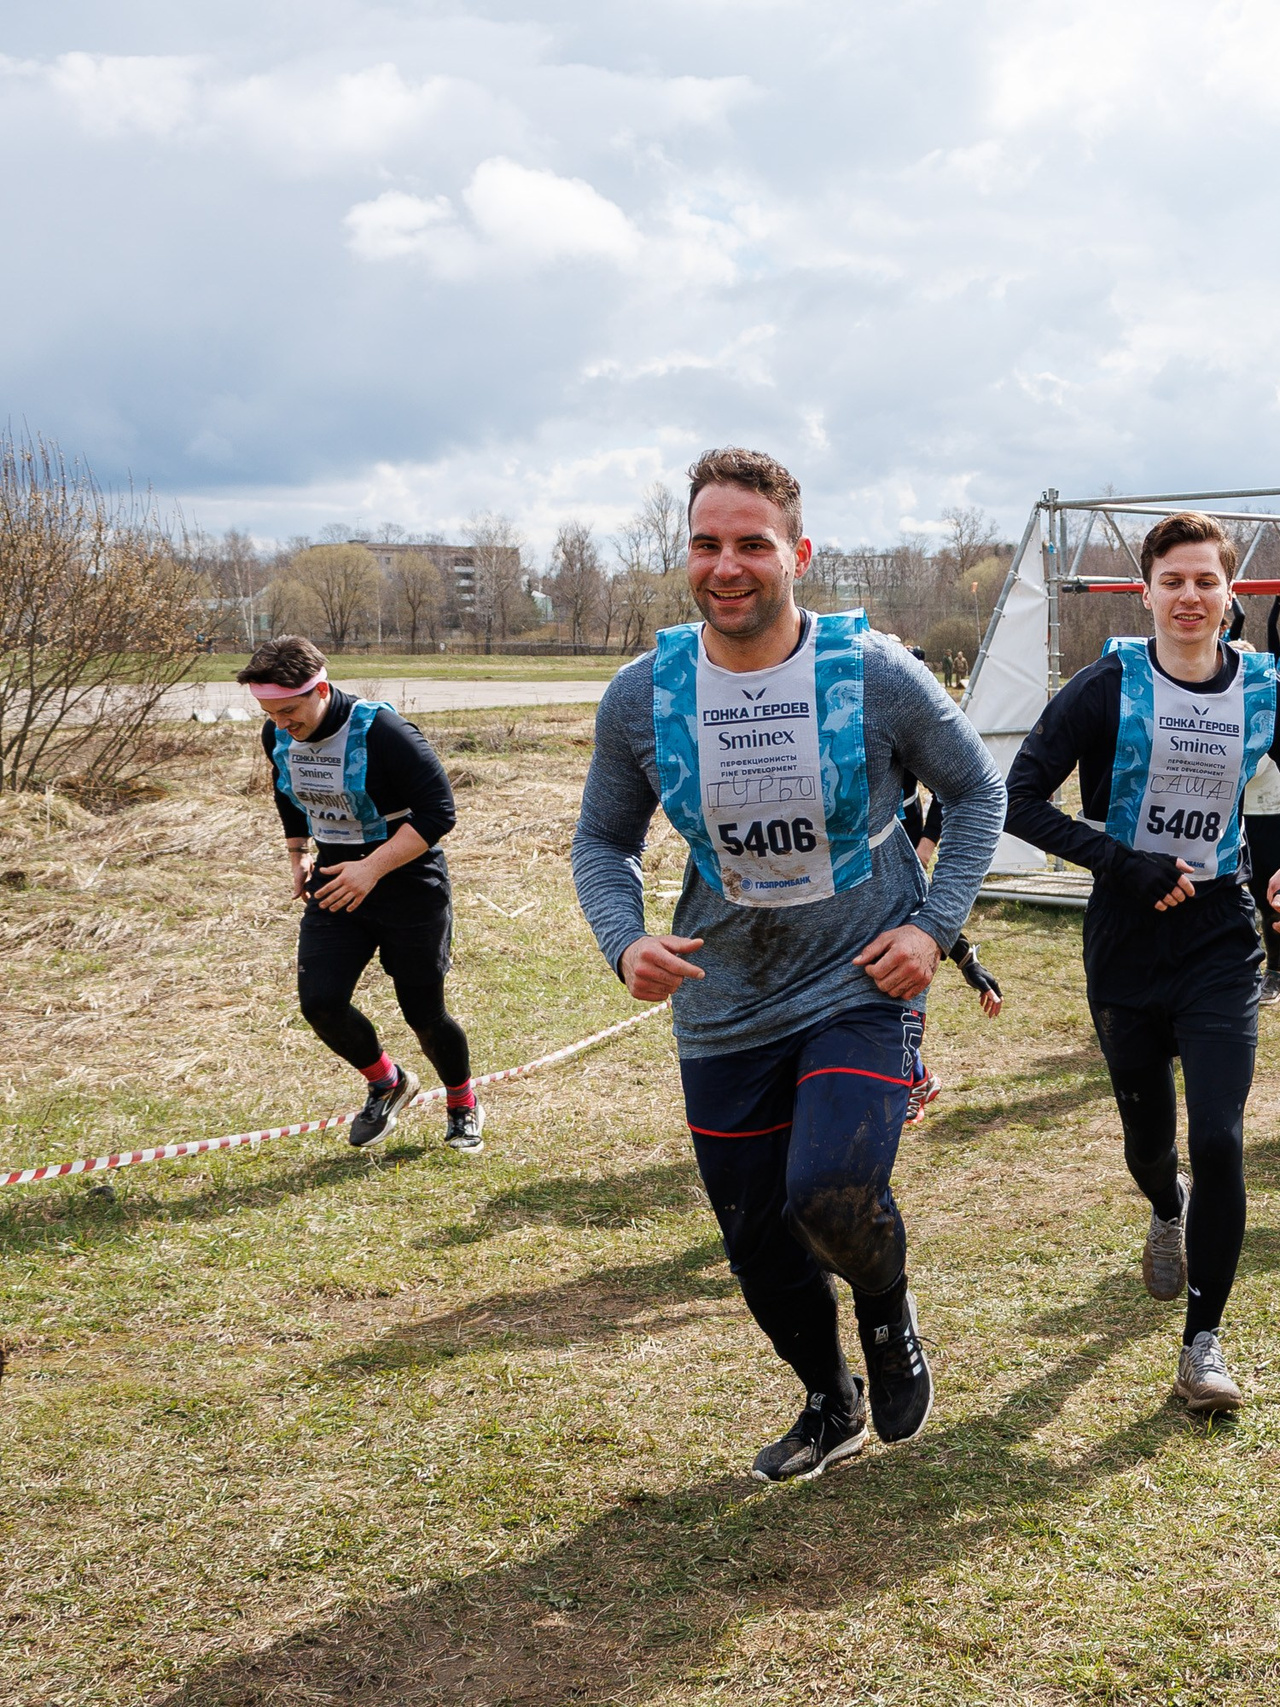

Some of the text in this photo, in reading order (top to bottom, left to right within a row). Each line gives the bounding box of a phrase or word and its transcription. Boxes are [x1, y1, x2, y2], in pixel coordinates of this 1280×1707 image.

[703, 702, 810, 722] ГОНКА ГЕРОЕВ
[1159, 716, 1240, 734] ГОНКА ГЕРОЕВ
[718, 730, 796, 751] Sminex
[1170, 735, 1227, 756] Sminex
[292, 753, 342, 764] ГОНКА ГЕРОЕВ
[720, 754, 798, 768] ПЕРФЕКЦИОНИСТЫ
[1167, 758, 1226, 770] ПЕРФЕКЦИОНИСТЫ
[299, 767, 334, 780] Sminex
[721, 764, 798, 778] FINE DEVELOPMENT
[1180, 766, 1225, 777] DEVELOPMENT
[1150, 774, 1228, 801] САША
[1146, 804, 1221, 843] 5408
[717, 816, 818, 858] 5406
[754, 876, 812, 890] ГАЗПРОМБАНК
[900, 1007, 924, 1077] ILA
